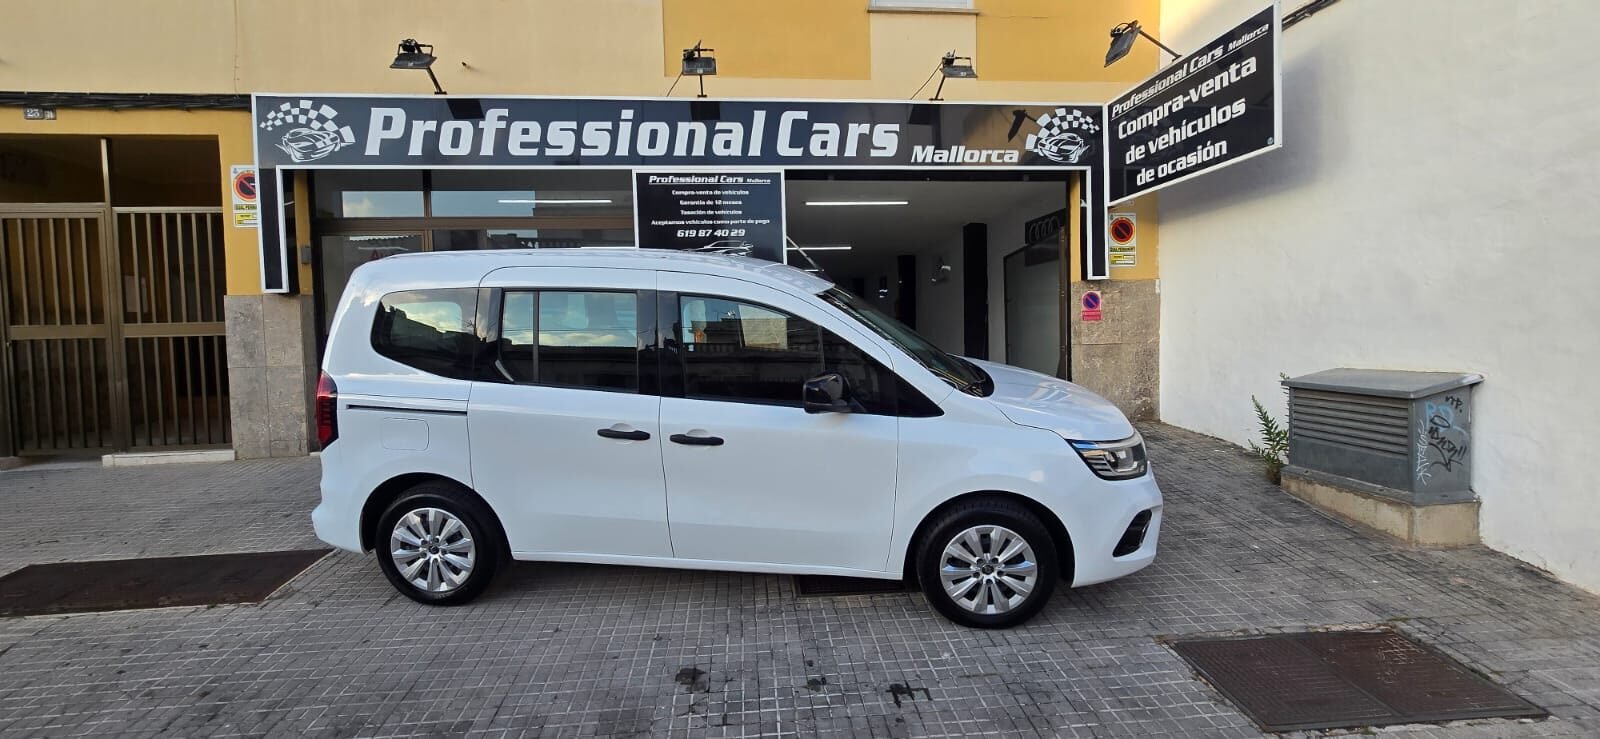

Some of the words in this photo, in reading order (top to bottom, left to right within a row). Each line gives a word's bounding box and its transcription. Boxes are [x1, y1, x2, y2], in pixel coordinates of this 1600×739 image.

[1112, 63, 1187, 118] Professional
[1189, 45, 1224, 73] Cars
[1227, 23, 1269, 51] Mallorca
[1118, 56, 1257, 139] Compra-venta
[364, 106, 767, 157] Professional
[776, 110, 901, 158] Cars
[910, 144, 1020, 164] Mallorca
[1125, 144, 1145, 165] de
[1148, 98, 1246, 155] vehículos
[649, 175, 719, 183] Professional
[719, 175, 744, 183] Cars
[1136, 165, 1155, 186] de
[1157, 139, 1227, 178] ocasión
[676, 229, 697, 238] 619
[698, 229, 712, 237] 87
[714, 229, 729, 237] 40
[730, 229, 745, 237] 29
